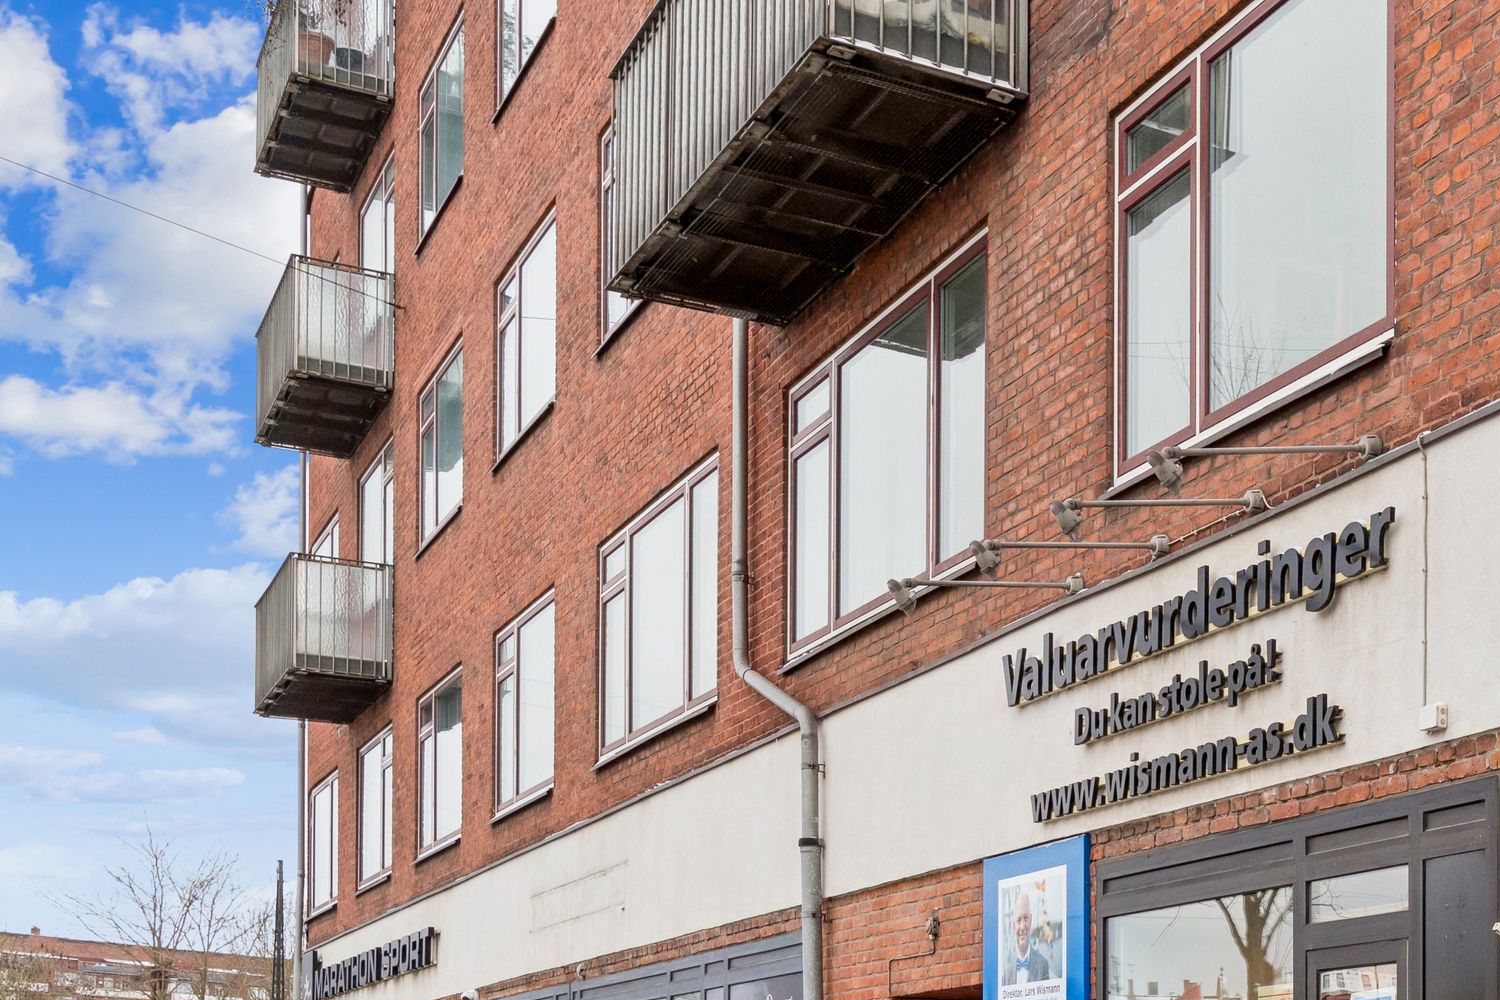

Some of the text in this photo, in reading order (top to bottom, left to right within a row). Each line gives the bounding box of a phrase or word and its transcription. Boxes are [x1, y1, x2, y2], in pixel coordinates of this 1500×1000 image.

[1002, 506, 1396, 708] Valuarvurderinger
[1074, 638, 1281, 746] Du kan stole på!
[1031, 693, 1342, 824] www.wismann-as.dk
[313, 926, 434, 1000] MARATHON SPORT
[1024, 986, 1036, 997] Lars
